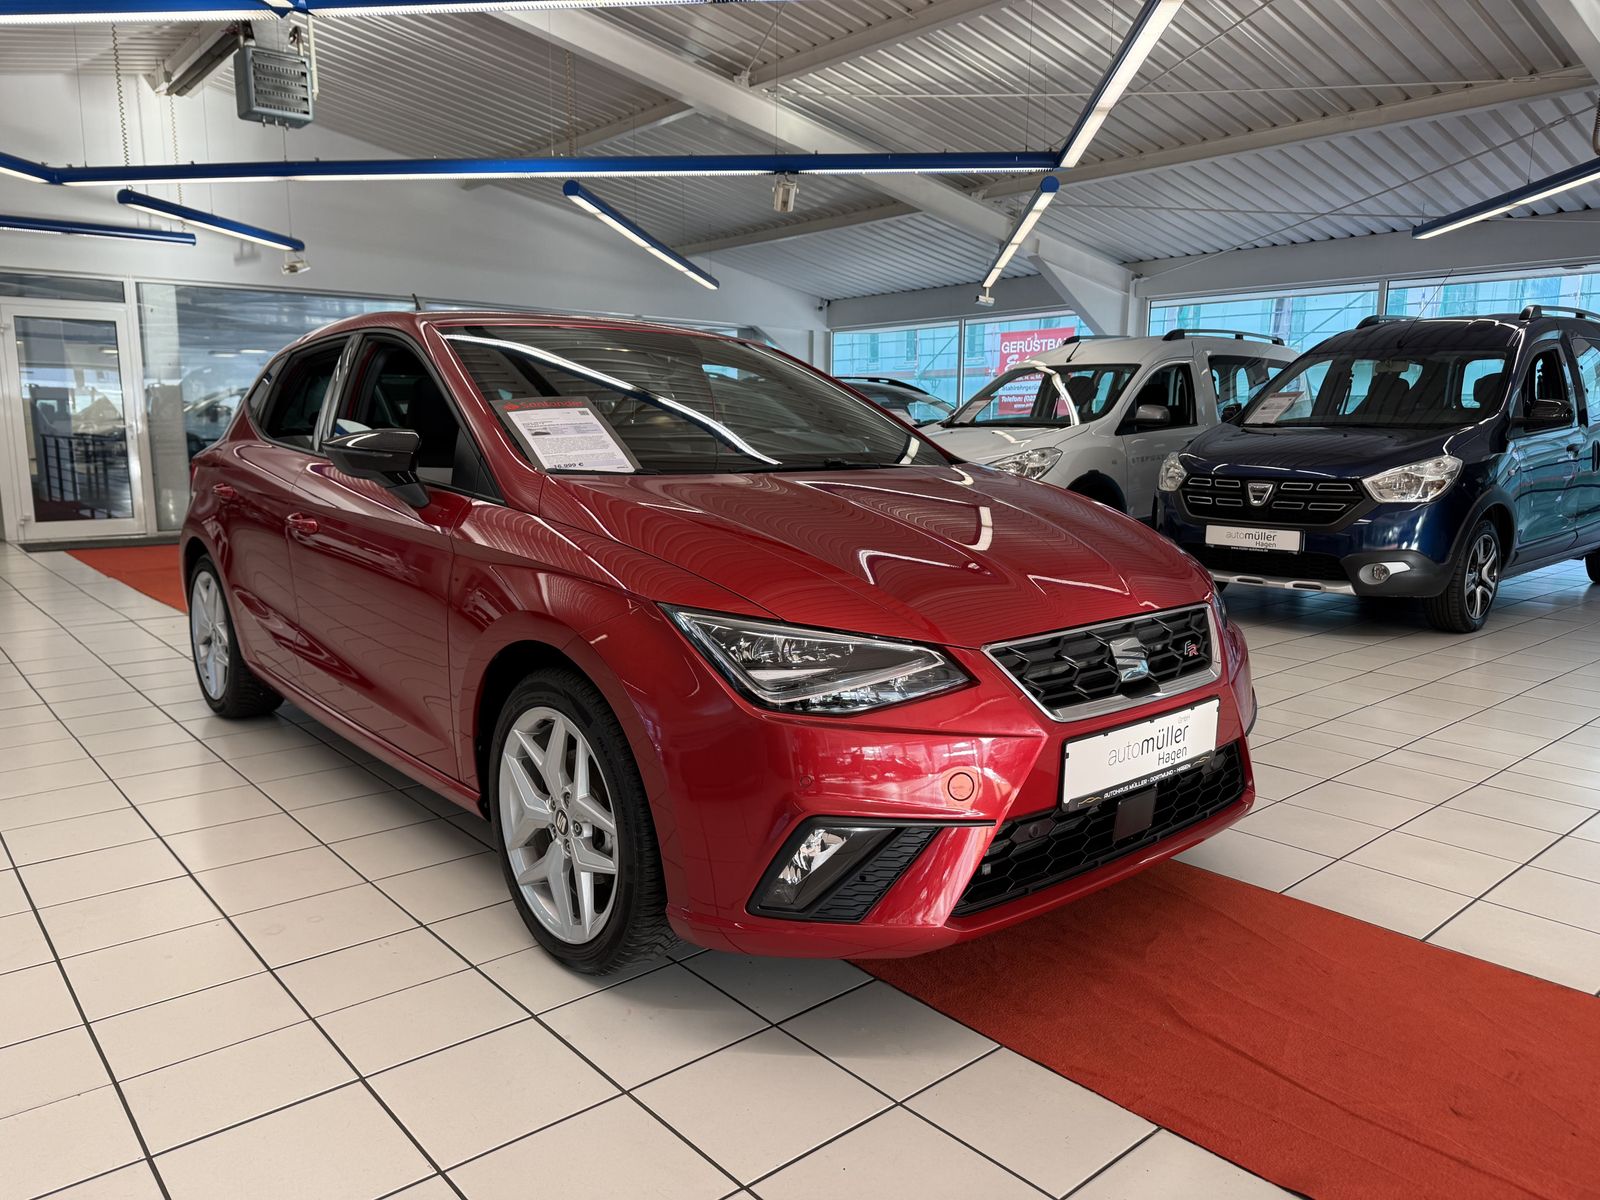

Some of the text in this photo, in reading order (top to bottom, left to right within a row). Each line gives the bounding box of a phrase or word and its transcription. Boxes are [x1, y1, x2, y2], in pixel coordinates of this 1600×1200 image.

[1001, 337, 1067, 354] GERÜSTBA
[1226, 530, 1277, 542] automüller
[1255, 541, 1277, 549] Hagen
[1108, 724, 1189, 767] automüller
[1157, 746, 1188, 766] Hagen
[1103, 763, 1192, 799] AUTOHAUS MÜLLER DORTMUND HAGEN
